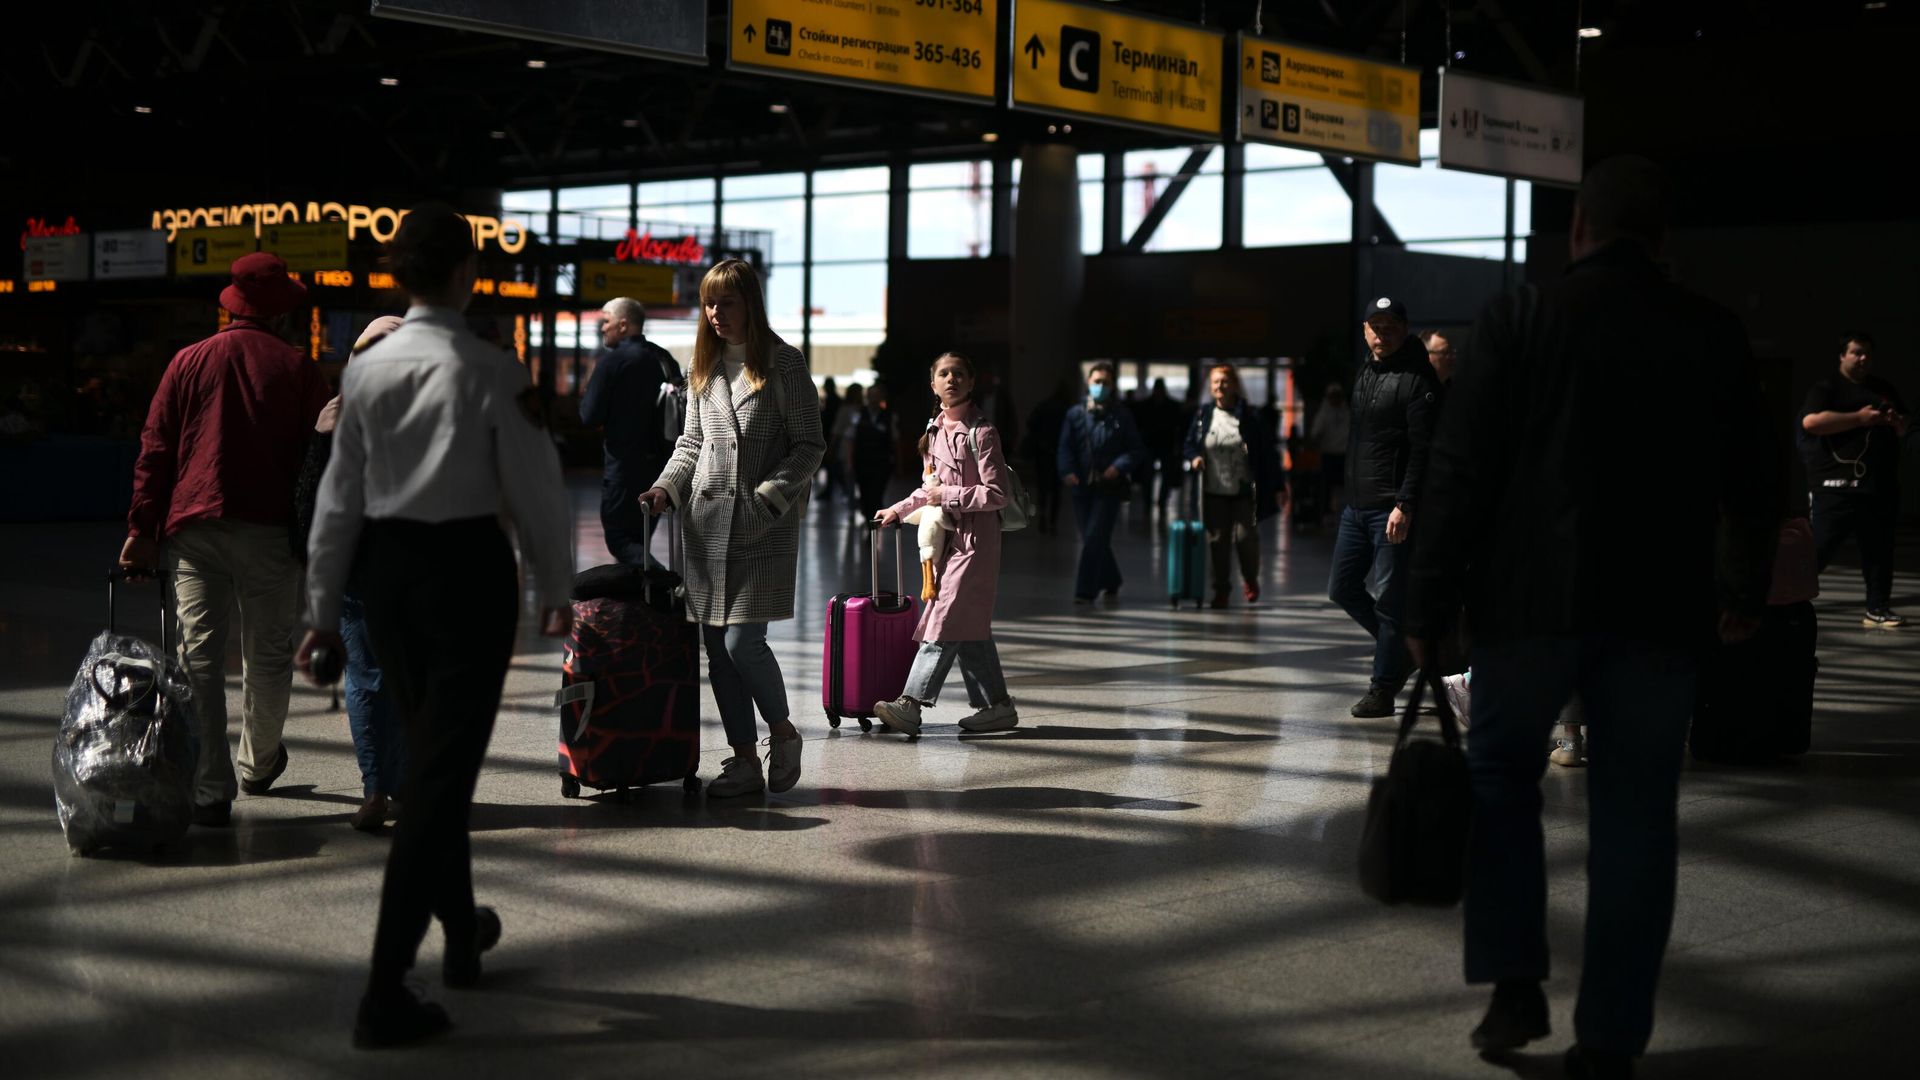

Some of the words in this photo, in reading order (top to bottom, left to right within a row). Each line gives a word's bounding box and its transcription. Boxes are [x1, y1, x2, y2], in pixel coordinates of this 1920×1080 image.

[799, 26, 839, 44] Стойки
[841, 35, 910, 55] регистрации
[914, 41, 981, 69] 365-436
[1112, 40, 1199, 77] Терминал
[1112, 80, 1163, 105] Terminal
